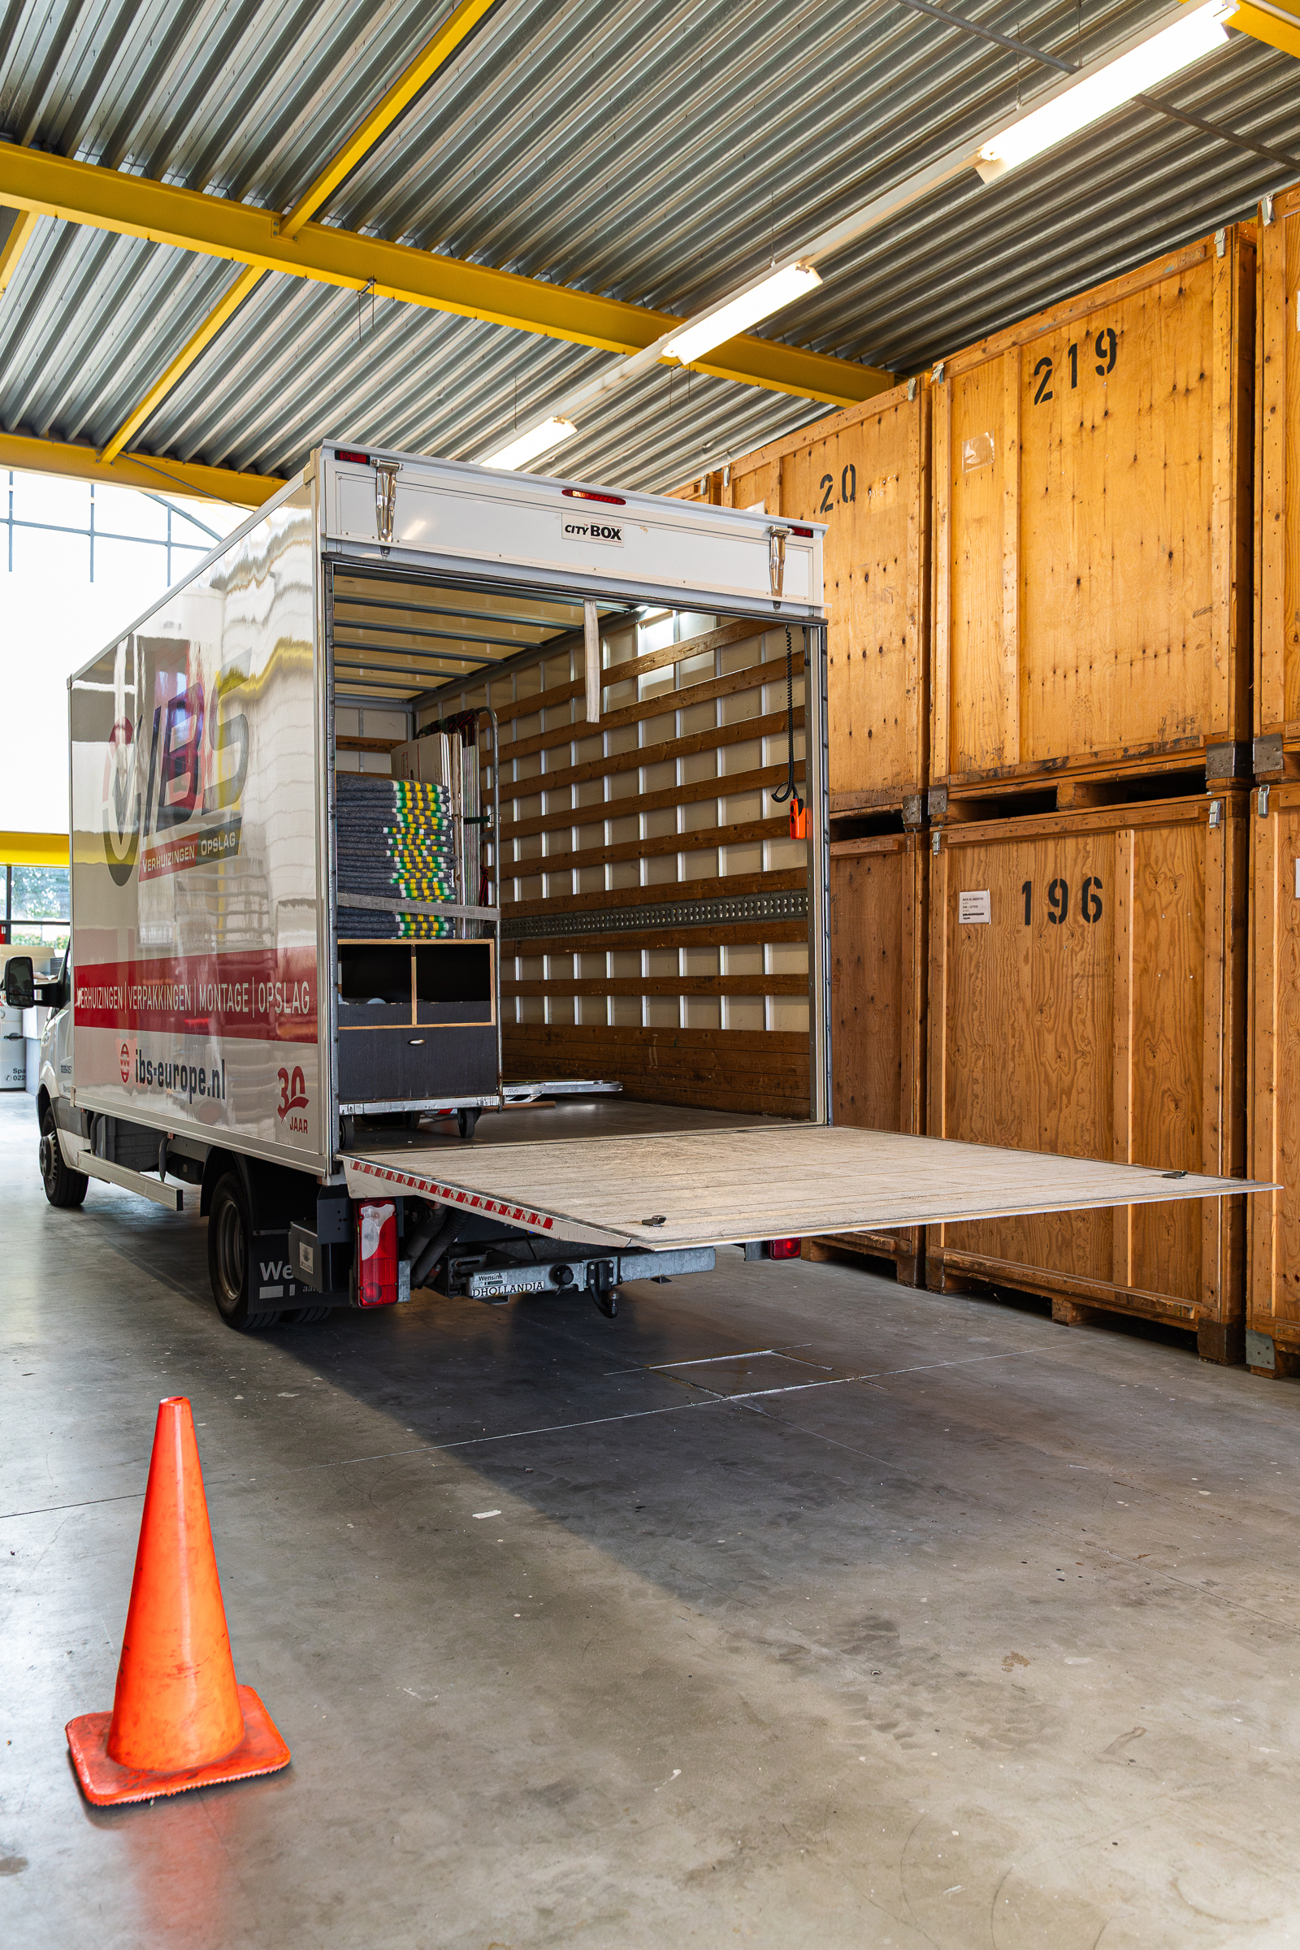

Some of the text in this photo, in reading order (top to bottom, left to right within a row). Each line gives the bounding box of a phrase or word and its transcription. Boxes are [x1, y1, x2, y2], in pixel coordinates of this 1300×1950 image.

[1033, 327, 1117, 406] 219
[819, 463, 856, 514] 20
[564, 524, 622, 541] CITY BOX
[143, 647, 253, 839] IBS
[142, 831, 236, 873] VERHUIZINGEN OPSLAG
[1021, 876, 1103, 926] 196
[76, 980, 310, 1015] VERHUIZINGEN VERPAKKINGEN MONTAGE OPSLAG
[135, 1049, 227, 1105] ibs-europe.nl
[277, 1065, 310, 1124] 30
[289, 1116, 309, 1134] JAAR
[473, 1282, 544, 1297] DHOLLANDIA
